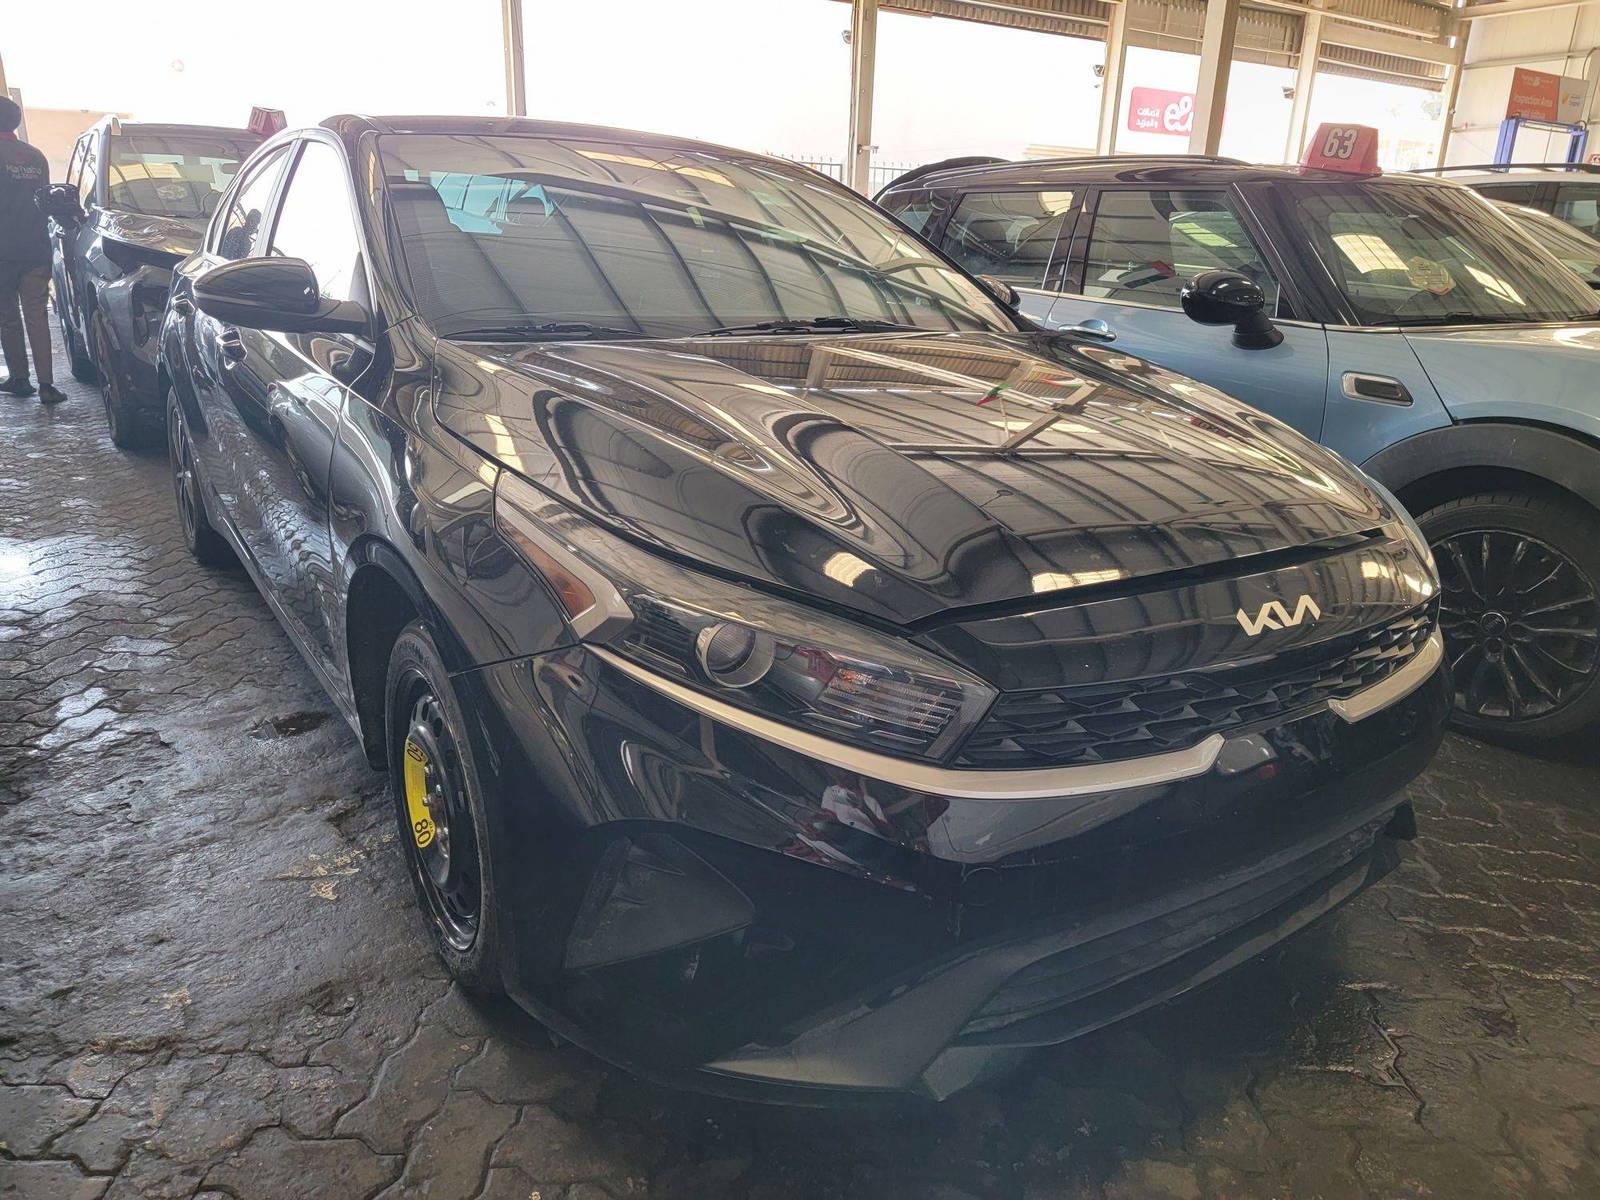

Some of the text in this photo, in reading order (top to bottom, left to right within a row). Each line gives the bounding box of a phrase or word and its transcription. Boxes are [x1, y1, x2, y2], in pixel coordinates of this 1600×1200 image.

[1323, 127, 1357, 159] 63
[1236, 594, 1321, 635] KIA
[415, 819, 431, 844] 80
